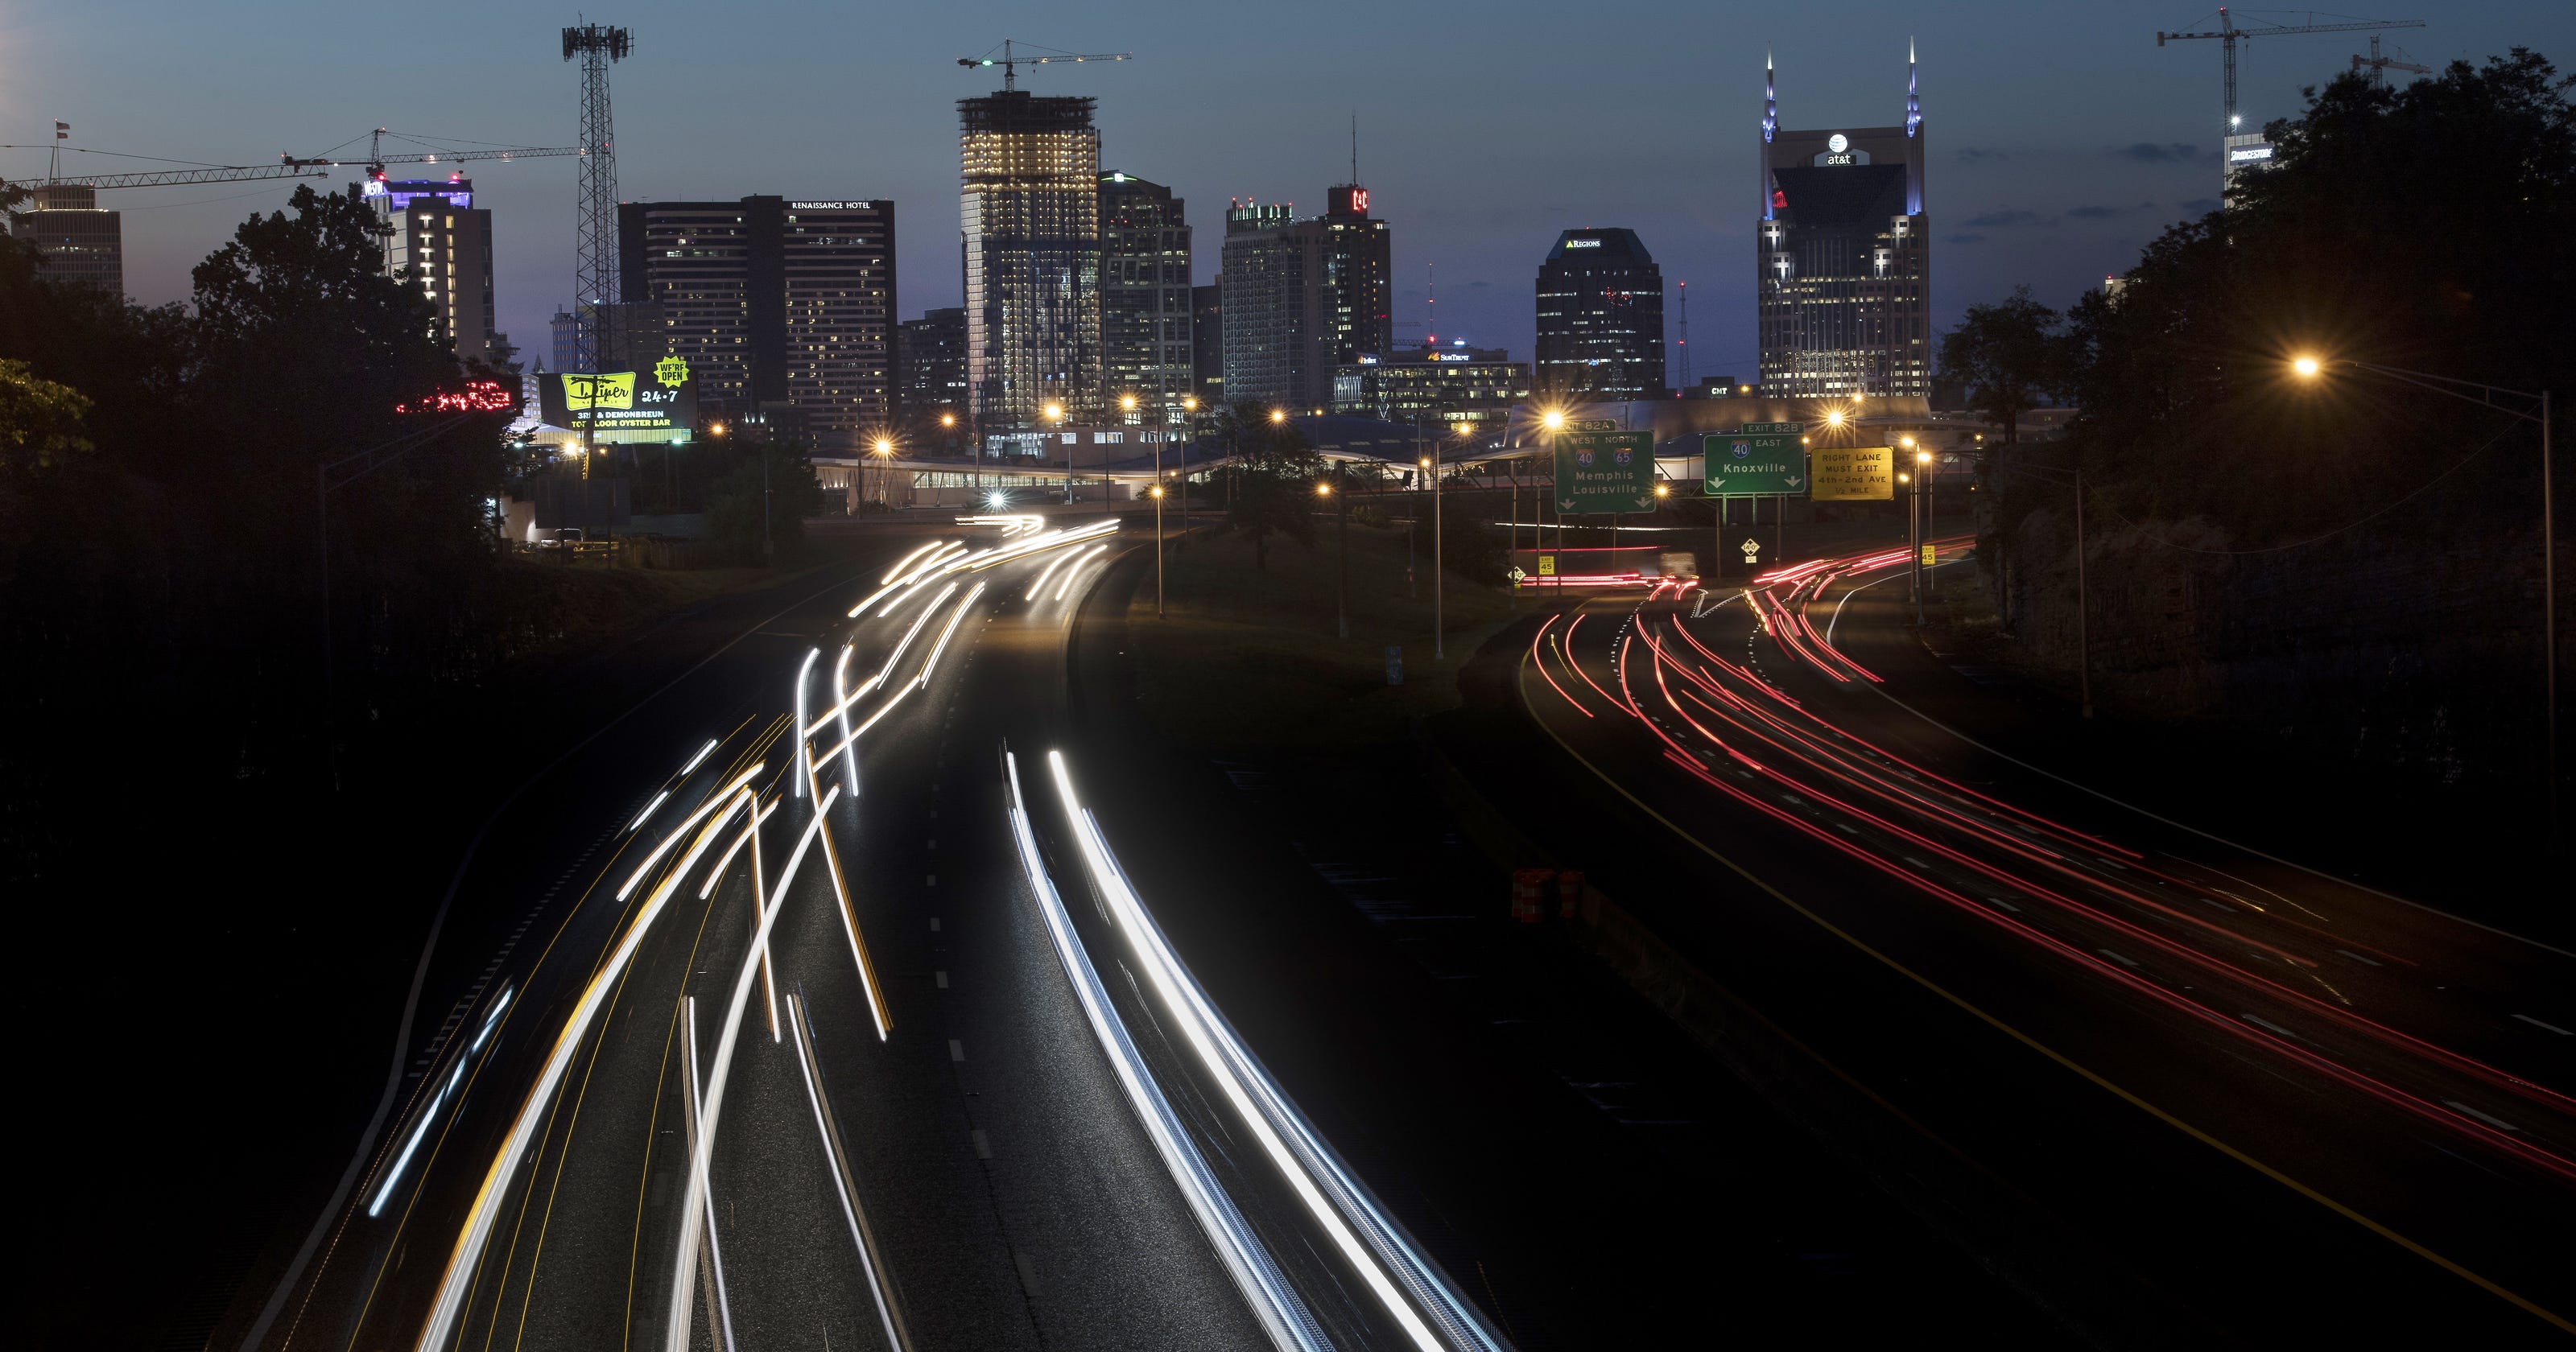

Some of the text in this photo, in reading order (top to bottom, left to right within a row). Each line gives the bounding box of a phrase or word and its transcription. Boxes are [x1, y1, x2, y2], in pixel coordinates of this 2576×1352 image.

[1827, 155, 1851, 165] at&t
[1573, 240, 1600, 248] REGIONS
[660, 363, 684, 372] WE'RE
[662, 371, 683, 381] OPEN
[605, 410, 664, 418] DEMONBREUN
[1585, 421, 1610, 430] 82A
[1774, 423, 1799, 432] 82B
[1605, 435, 1637, 444] NORTH
[1733, 439, 1781, 455] 40 EAST
[1579, 453, 1630, 464] 40 65
[1822, 454, 1851, 462] RIGHT
[1724, 464, 1786, 473] Knoxville
[1576, 471, 1634, 482] Memphis
[1572, 484, 1637, 495] Louisville
